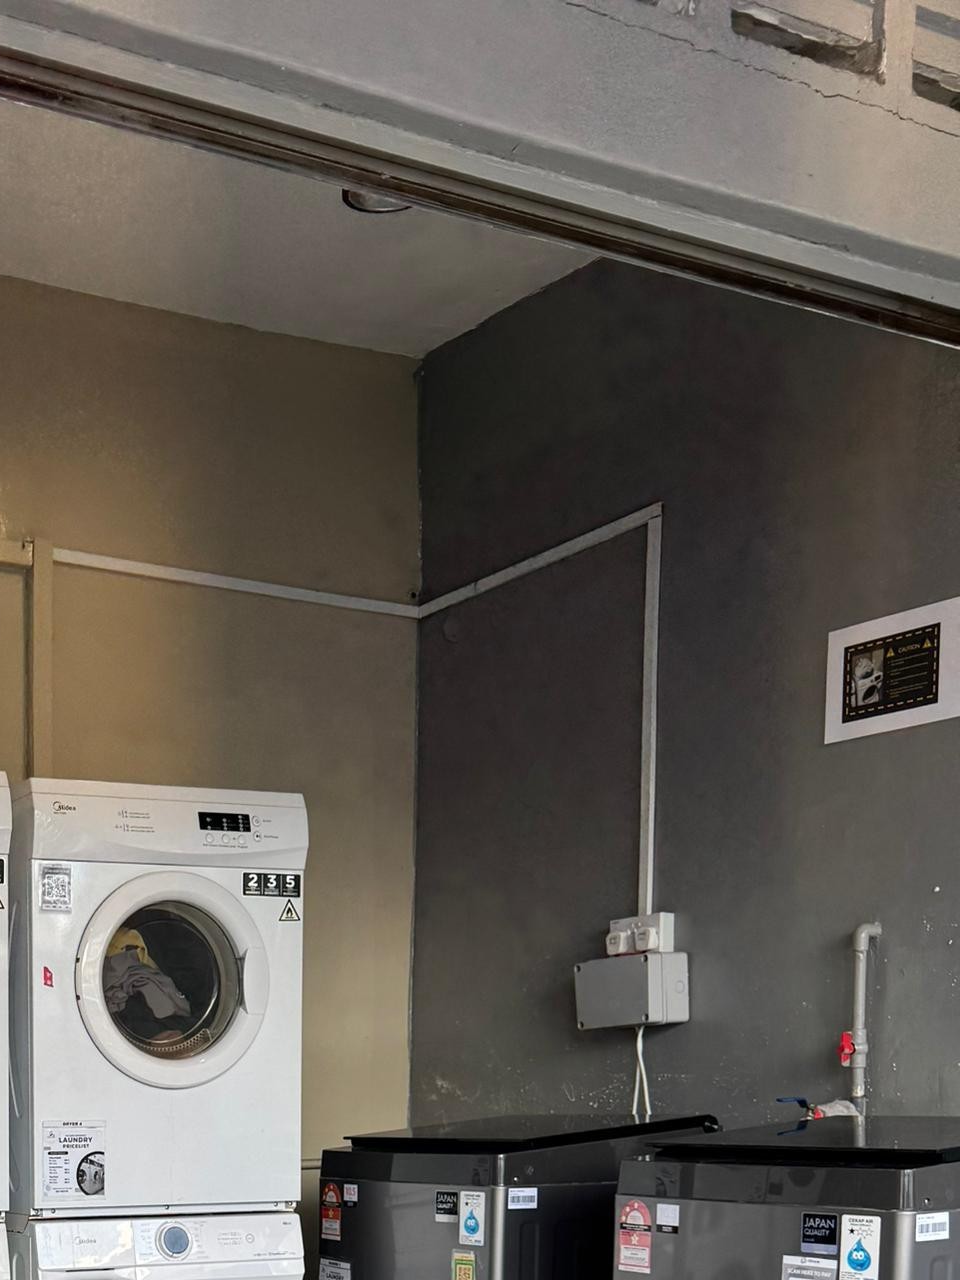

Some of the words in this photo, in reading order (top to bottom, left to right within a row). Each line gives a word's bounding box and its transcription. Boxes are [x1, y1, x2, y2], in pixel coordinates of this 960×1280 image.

[53, 801, 76, 811] Midea
[248, 874, 258, 887] 2
[267, 875, 277, 887] 3
[286, 876, 295, 887] 5
[804, 1217, 835, 1228] JAPAN
[804, 1228, 830, 1236] QUALITY
